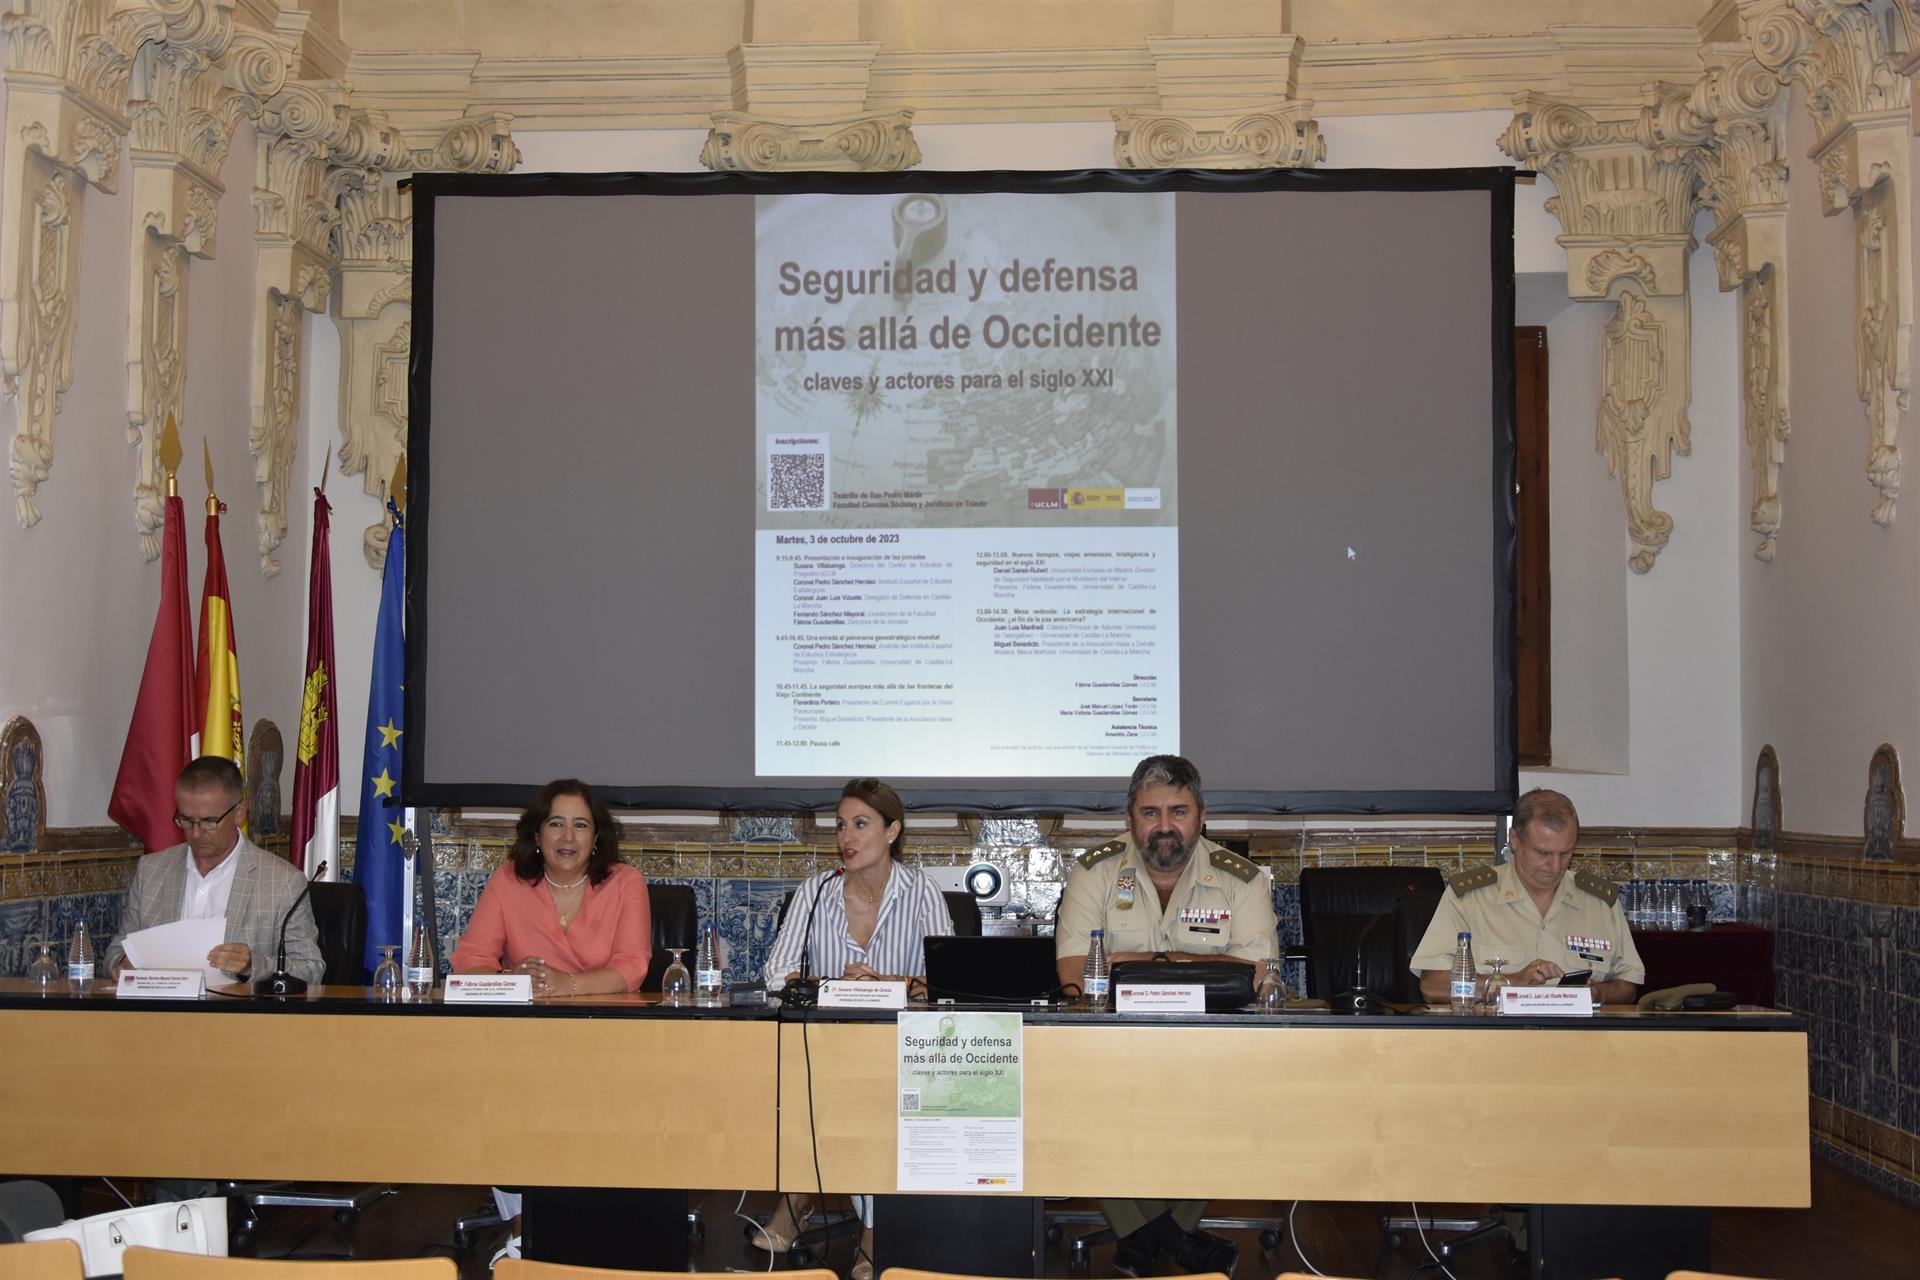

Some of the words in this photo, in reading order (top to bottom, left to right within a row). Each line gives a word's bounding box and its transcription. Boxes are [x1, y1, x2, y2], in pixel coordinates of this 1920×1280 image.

[778, 260, 956, 303] Seguridad
[968, 267, 988, 301] y
[999, 259, 1138, 292] defensa
[774, 316, 846, 351] más
[858, 315, 918, 350] allá
[929, 316, 971, 349] de
[983, 314, 1161, 348] Occidente
[803, 371, 863, 391] claves
[868, 376, 879, 394] y
[885, 374, 954, 390] actores
[960, 374, 1001, 393] para
[1007, 370, 1025, 389] el
[1030, 370, 1076, 392] siglo
[1081, 369, 1114, 388] XXI
[775, 437, 820, 447] Inscripciones:
[776, 535, 808, 545] Martes,
[810, 535, 816, 544] 3
[818, 535, 828, 544] de
[830, 535, 864, 544] octubre
[866, 534, 876, 543] de
[878, 534, 900, 543] 2023
[905, 1036, 958, 1049] Seguridad
[961, 1038, 968, 1048] y
[970, 1036, 1012, 1046] defensa
[904, 1053, 926, 1064] más
[928, 1053, 946, 1064] allá
[950, 1053, 962, 1064] de
[966, 1052, 1018, 1064] Occidente
